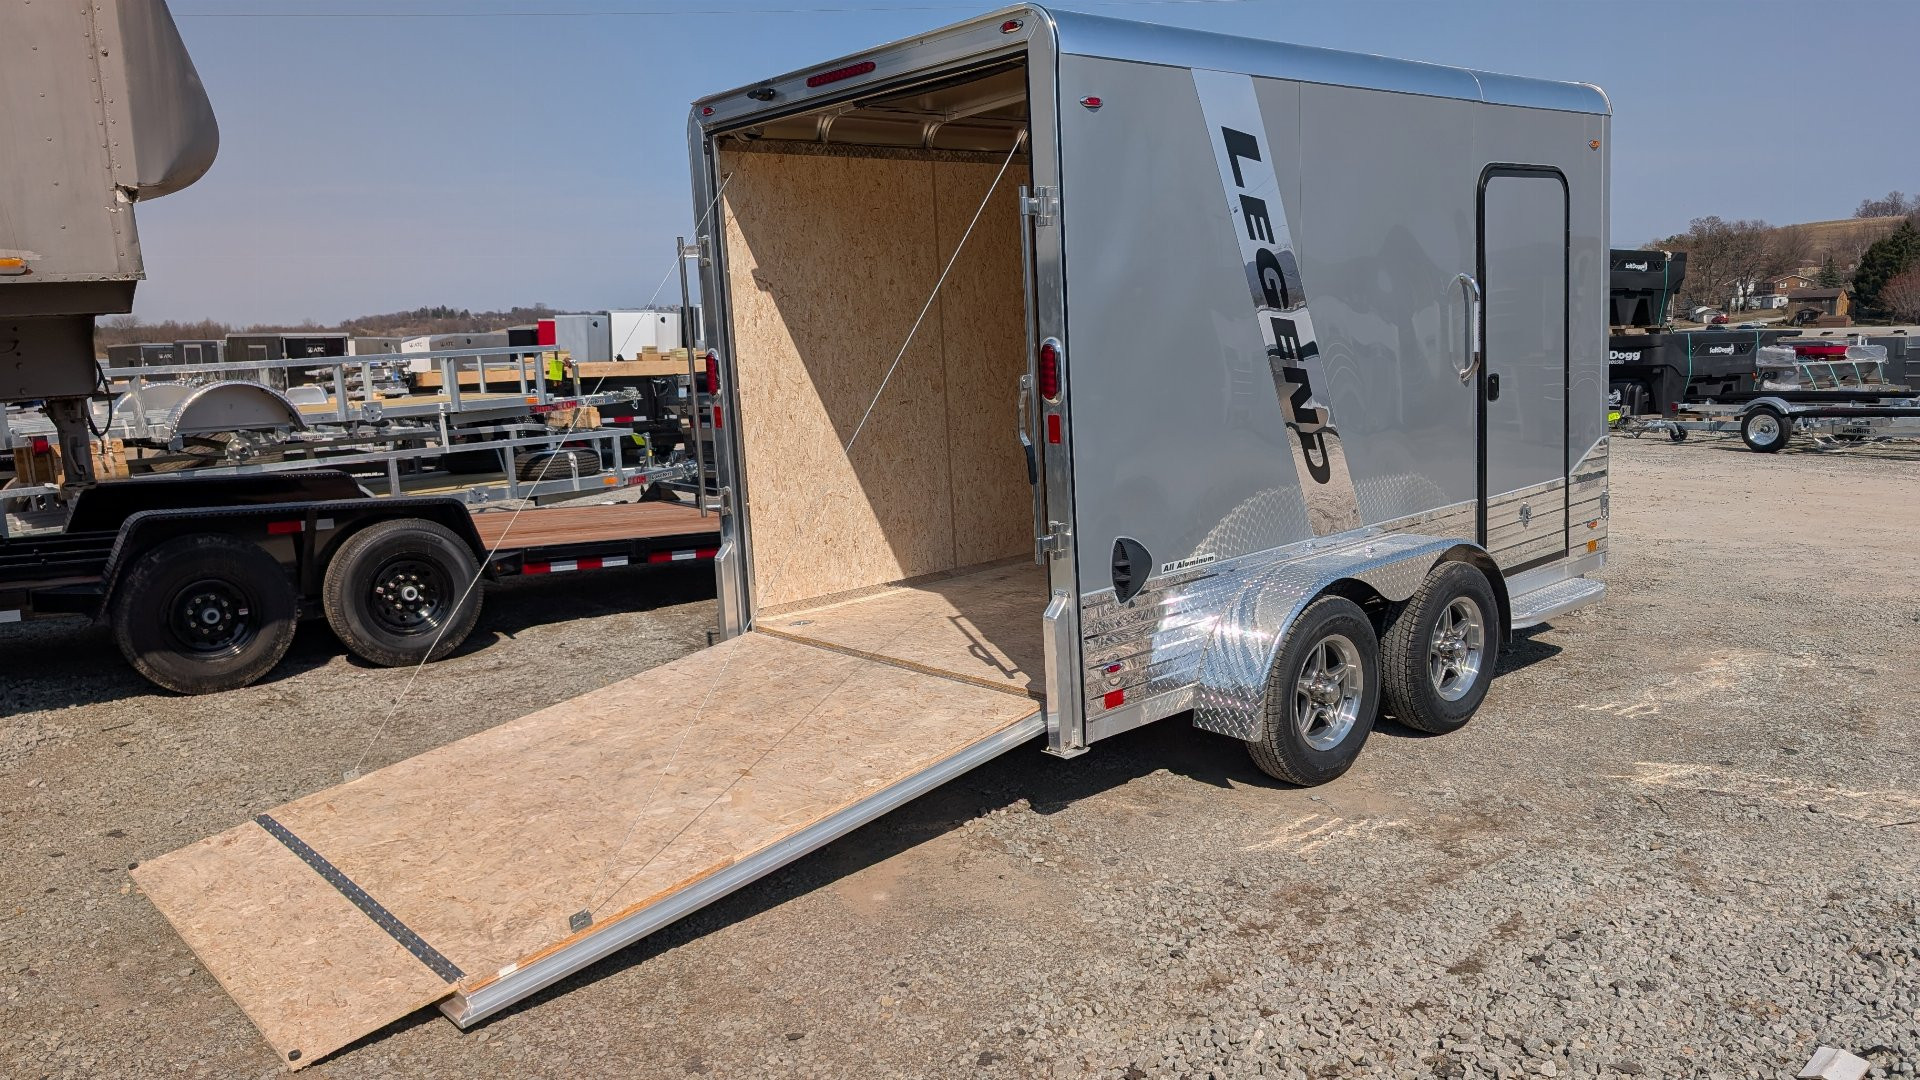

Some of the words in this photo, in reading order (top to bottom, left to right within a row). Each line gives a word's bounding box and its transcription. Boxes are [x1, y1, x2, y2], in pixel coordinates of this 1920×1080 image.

[1221, 126, 1331, 485] LEGEND
[1163, 563, 1175, 573] All
[1176, 555, 1214, 569] Aluminum
